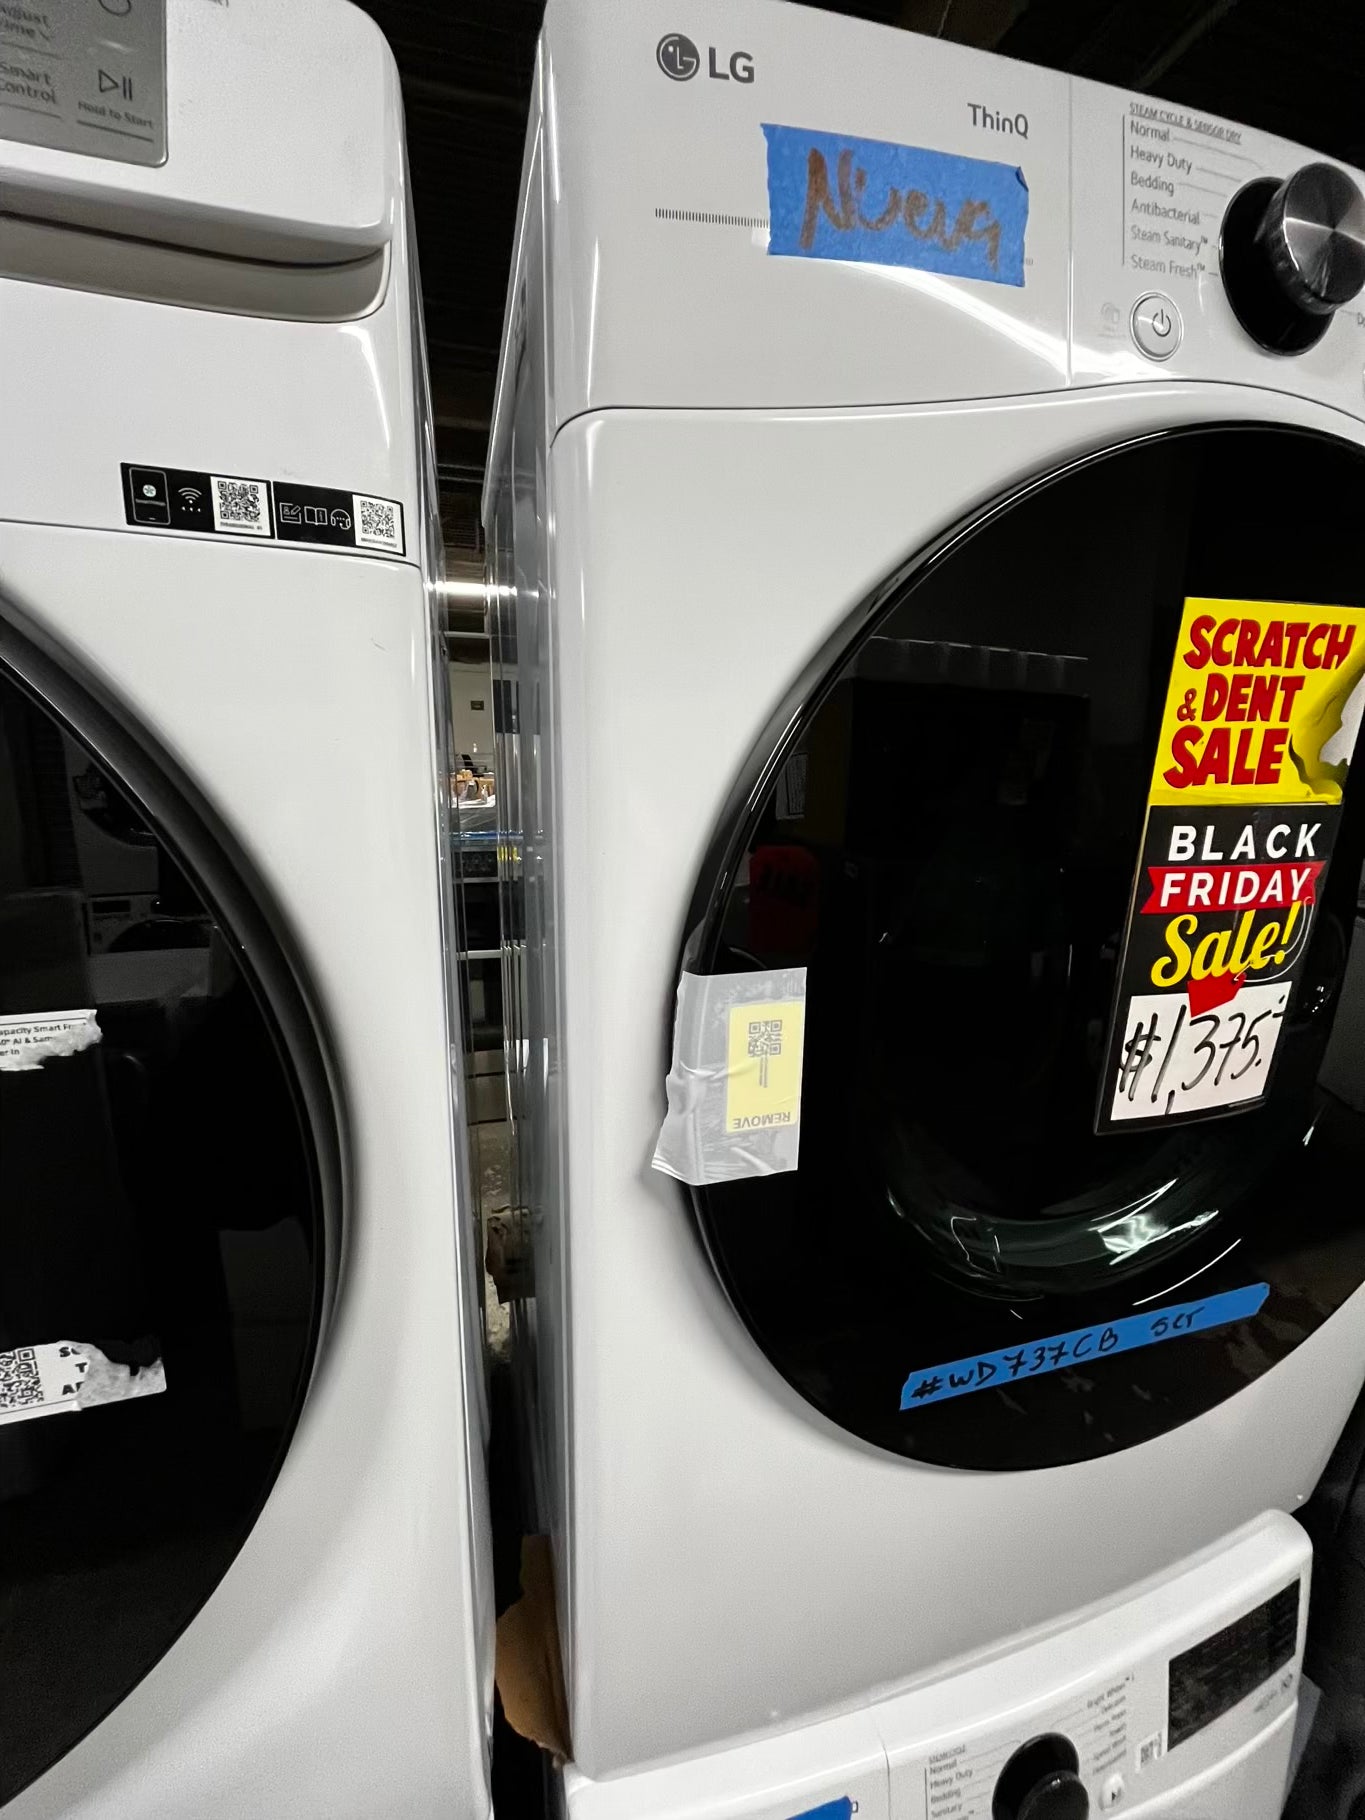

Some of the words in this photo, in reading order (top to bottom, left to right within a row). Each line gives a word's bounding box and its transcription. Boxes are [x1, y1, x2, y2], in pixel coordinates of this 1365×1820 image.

[708, 46, 755, 83] LG
[967, 103, 1029, 139] ThinQ
[1130, 119, 1171, 142] Normal
[1130, 144, 1165, 169] Heavy
[1167, 152, 1193, 176] Duty
[1130, 170, 1175, 197] Bedding
[1131, 198, 1201, 225] Antibacterial
[1131, 224, 1161, 243] Steam
[1131, 254, 1166, 274] Steam
[1183, 614, 1357, 670] SCRATCH
[1176, 687, 1198, 722] &
[1201, 672, 1306, 722] DENT
[1162, 724, 1290, 789] SALE
[1167, 823, 1322, 862] BLACK
[1159, 867, 1311, 908] FRIDAY
[1150, 900, 1302, 988] Sale!
[33, 1024, 61, 1033] Smart
[733, 1111, 791, 1130] REMOVE
